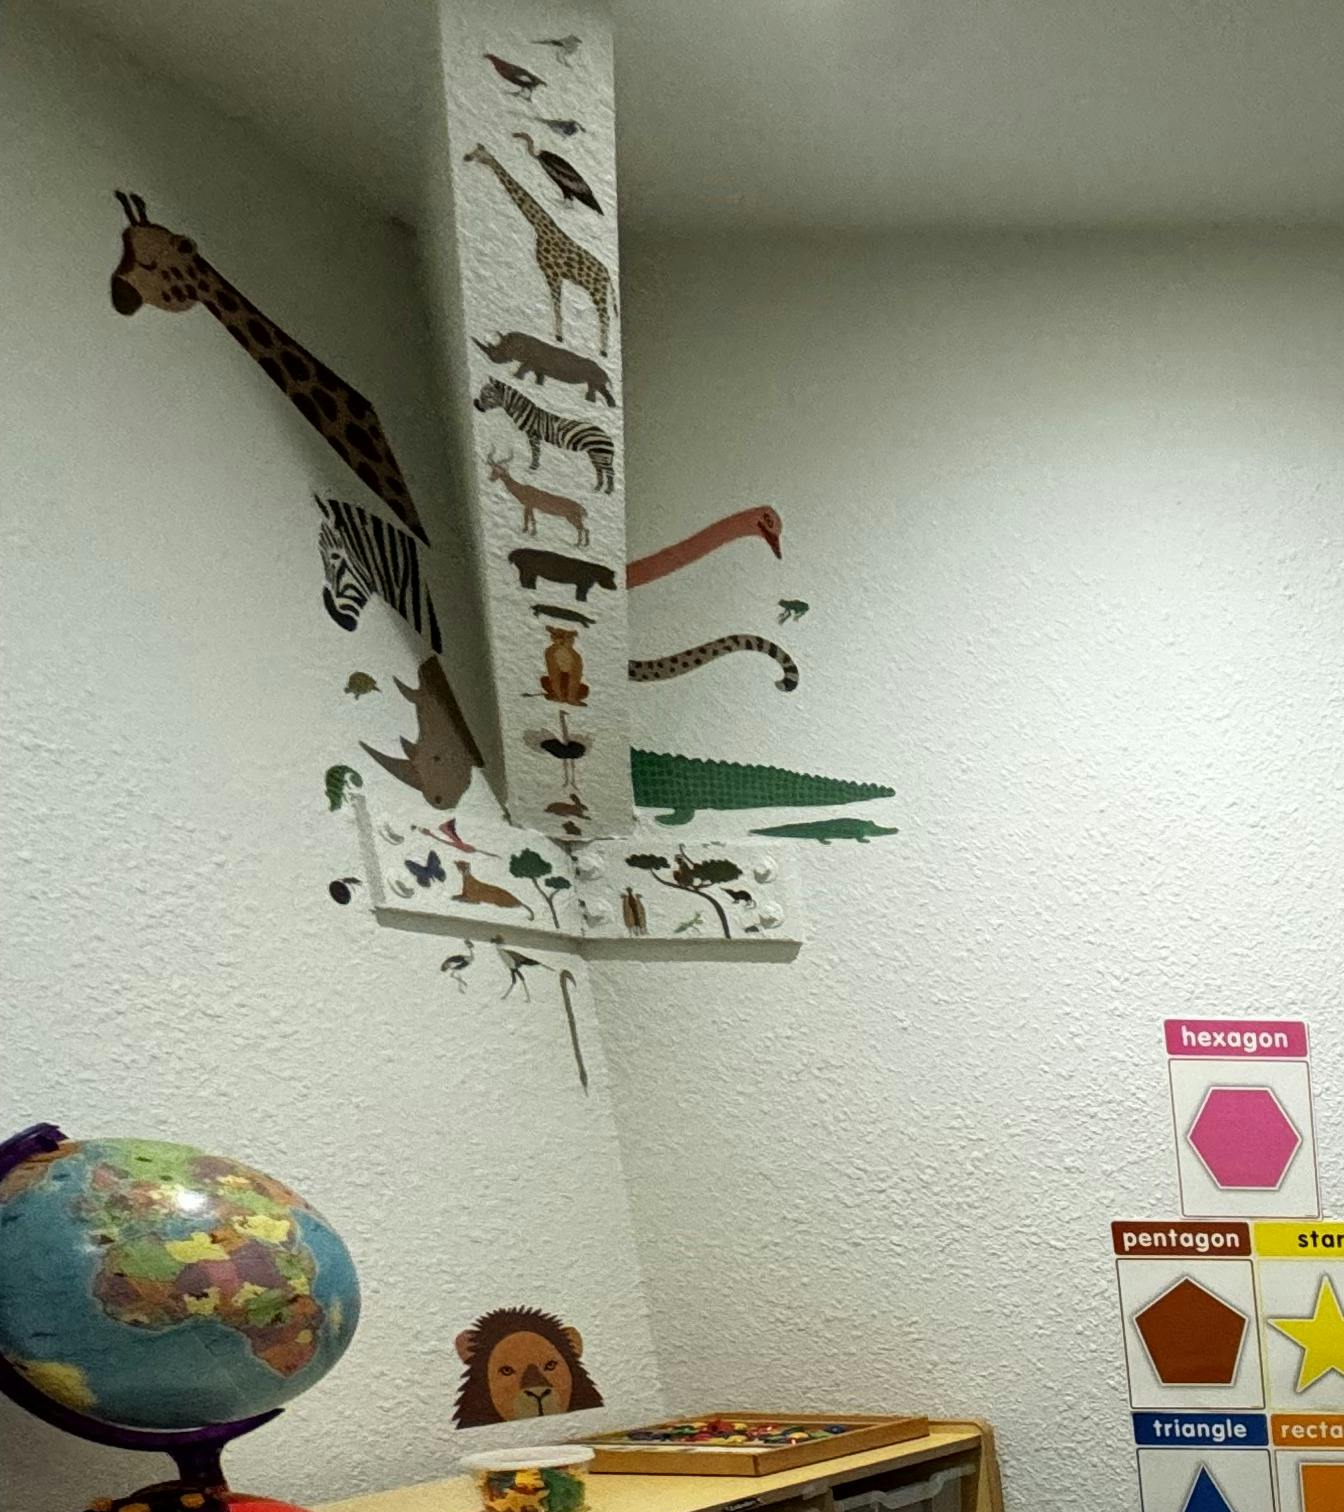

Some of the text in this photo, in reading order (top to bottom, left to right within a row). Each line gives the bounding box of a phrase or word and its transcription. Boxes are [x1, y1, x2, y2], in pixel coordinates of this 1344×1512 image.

[1181, 1026, 1288, 1052] hexagon
[1123, 1229, 1240, 1252] pentagon
[1298, 1230, 1344, 1249] star
[1153, 1420, 1247, 1441] triangle
